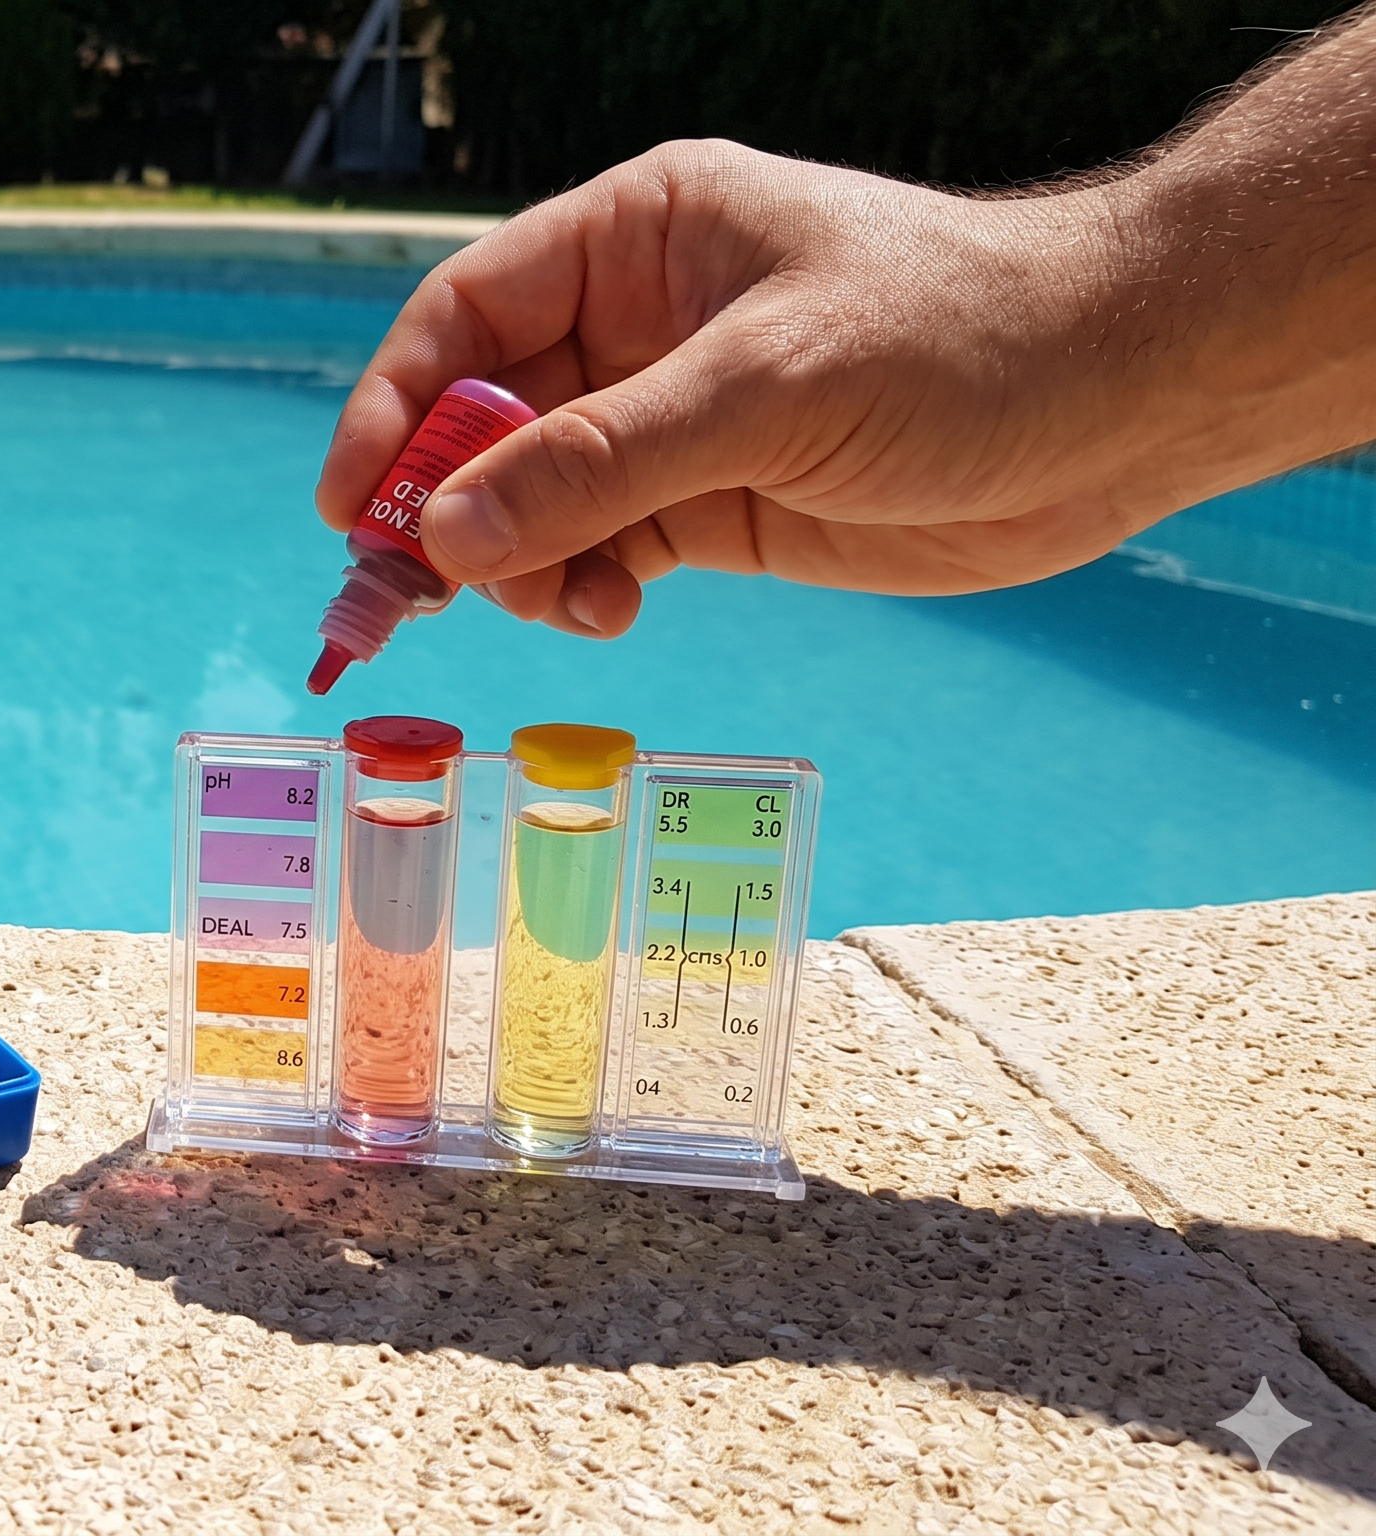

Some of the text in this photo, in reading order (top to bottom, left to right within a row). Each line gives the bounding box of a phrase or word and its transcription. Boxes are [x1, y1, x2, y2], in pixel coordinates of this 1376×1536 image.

[206, 772, 231, 793] pH
[287, 788, 314, 805] 8.2
[662, 791, 781, 813] DR CL
[659, 815, 782, 838] 5.5 3.0
[284, 855, 310, 873] 7.8
[652, 877, 773, 901] 3.4 1.5
[202, 917, 307, 939] DEAL 7.5
[647, 943, 676, 961] 2.2
[739, 950, 767, 967] 1.0
[279, 986, 306, 1003] 7.2
[642, 1011, 759, 1035] 1.3 0.6
[277, 1050, 304, 1067] 8.6
[636, 1078, 753, 1103] 04 0.2
